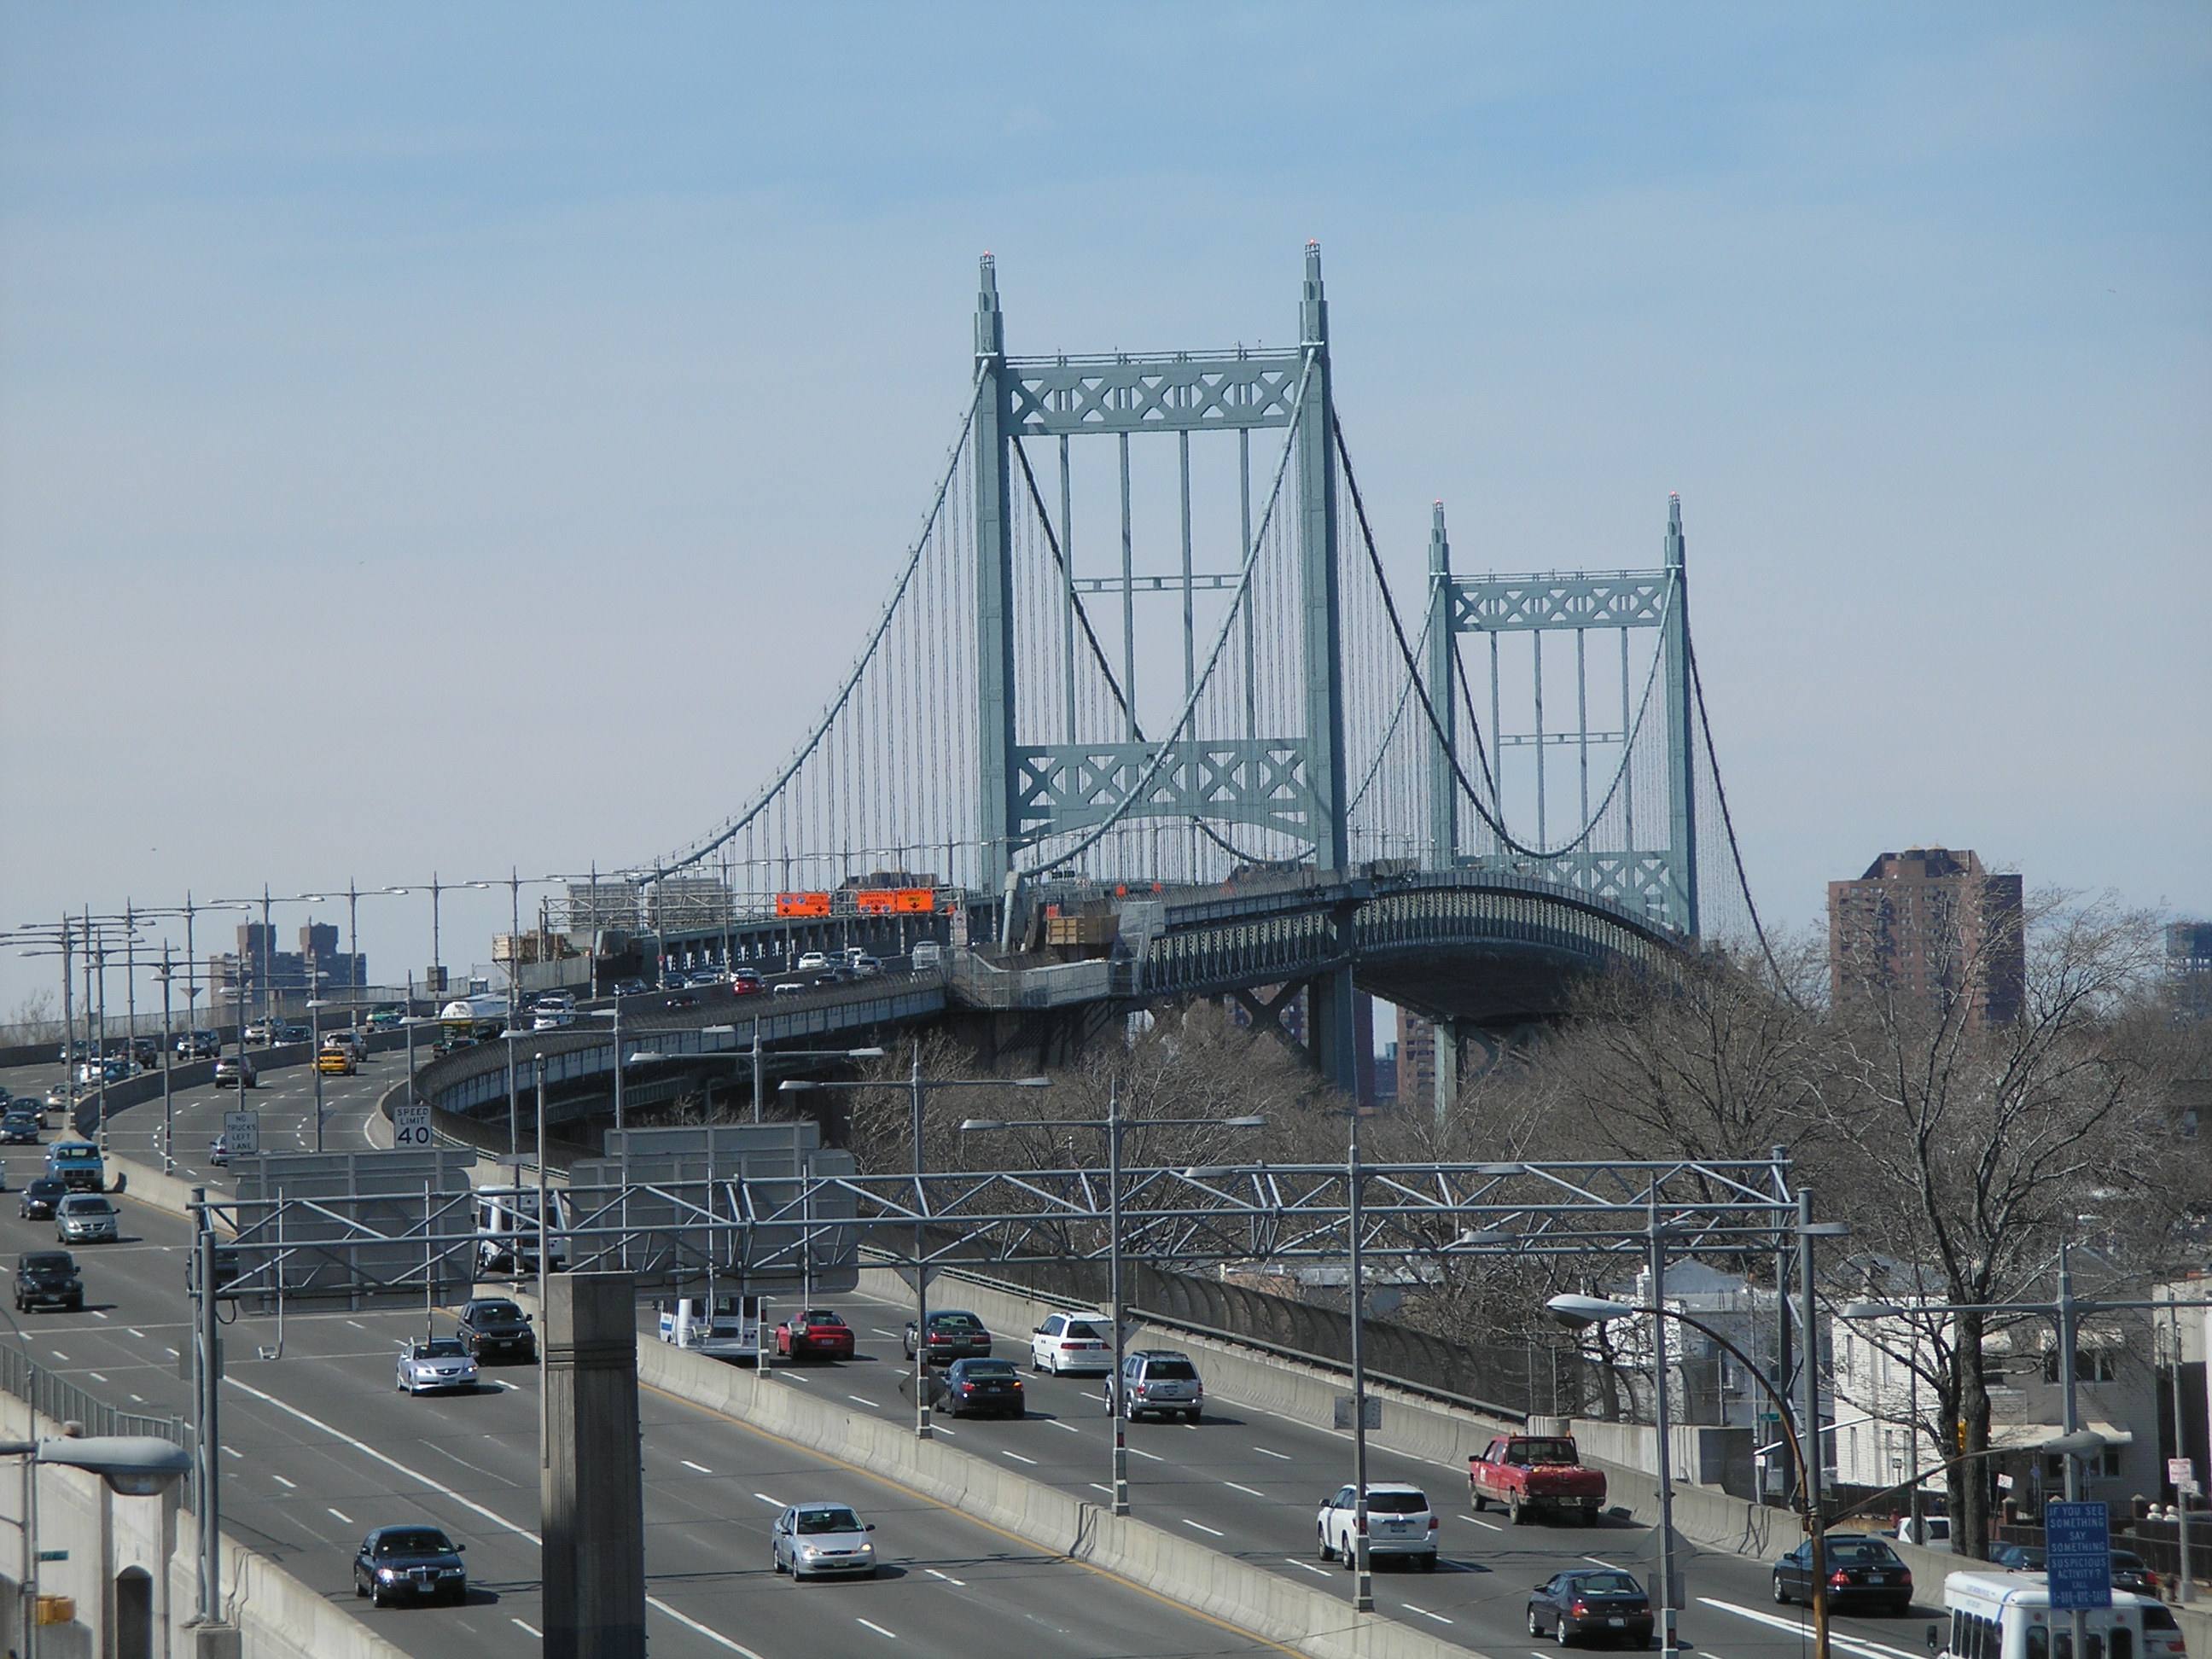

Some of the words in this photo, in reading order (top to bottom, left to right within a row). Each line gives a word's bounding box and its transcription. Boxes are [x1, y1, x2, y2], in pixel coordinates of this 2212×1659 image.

[397, 1108, 429, 1116] SPEED
[398, 1126, 429, 1144] 40
[232, 1142, 252, 1150] LANE
[2048, 1506, 2058, 1516] IF
[2062, 1506, 2081, 1516] YOU
[2085, 1505, 2104, 1516] SEE
[2050, 1517, 2104, 1528] SOMETHING
[2069, 1530, 2087, 1541] SAY
[2052, 1542, 2105, 1552] SOMETHING
[2052, 1557, 2106, 1569] SUSPICIOUS
